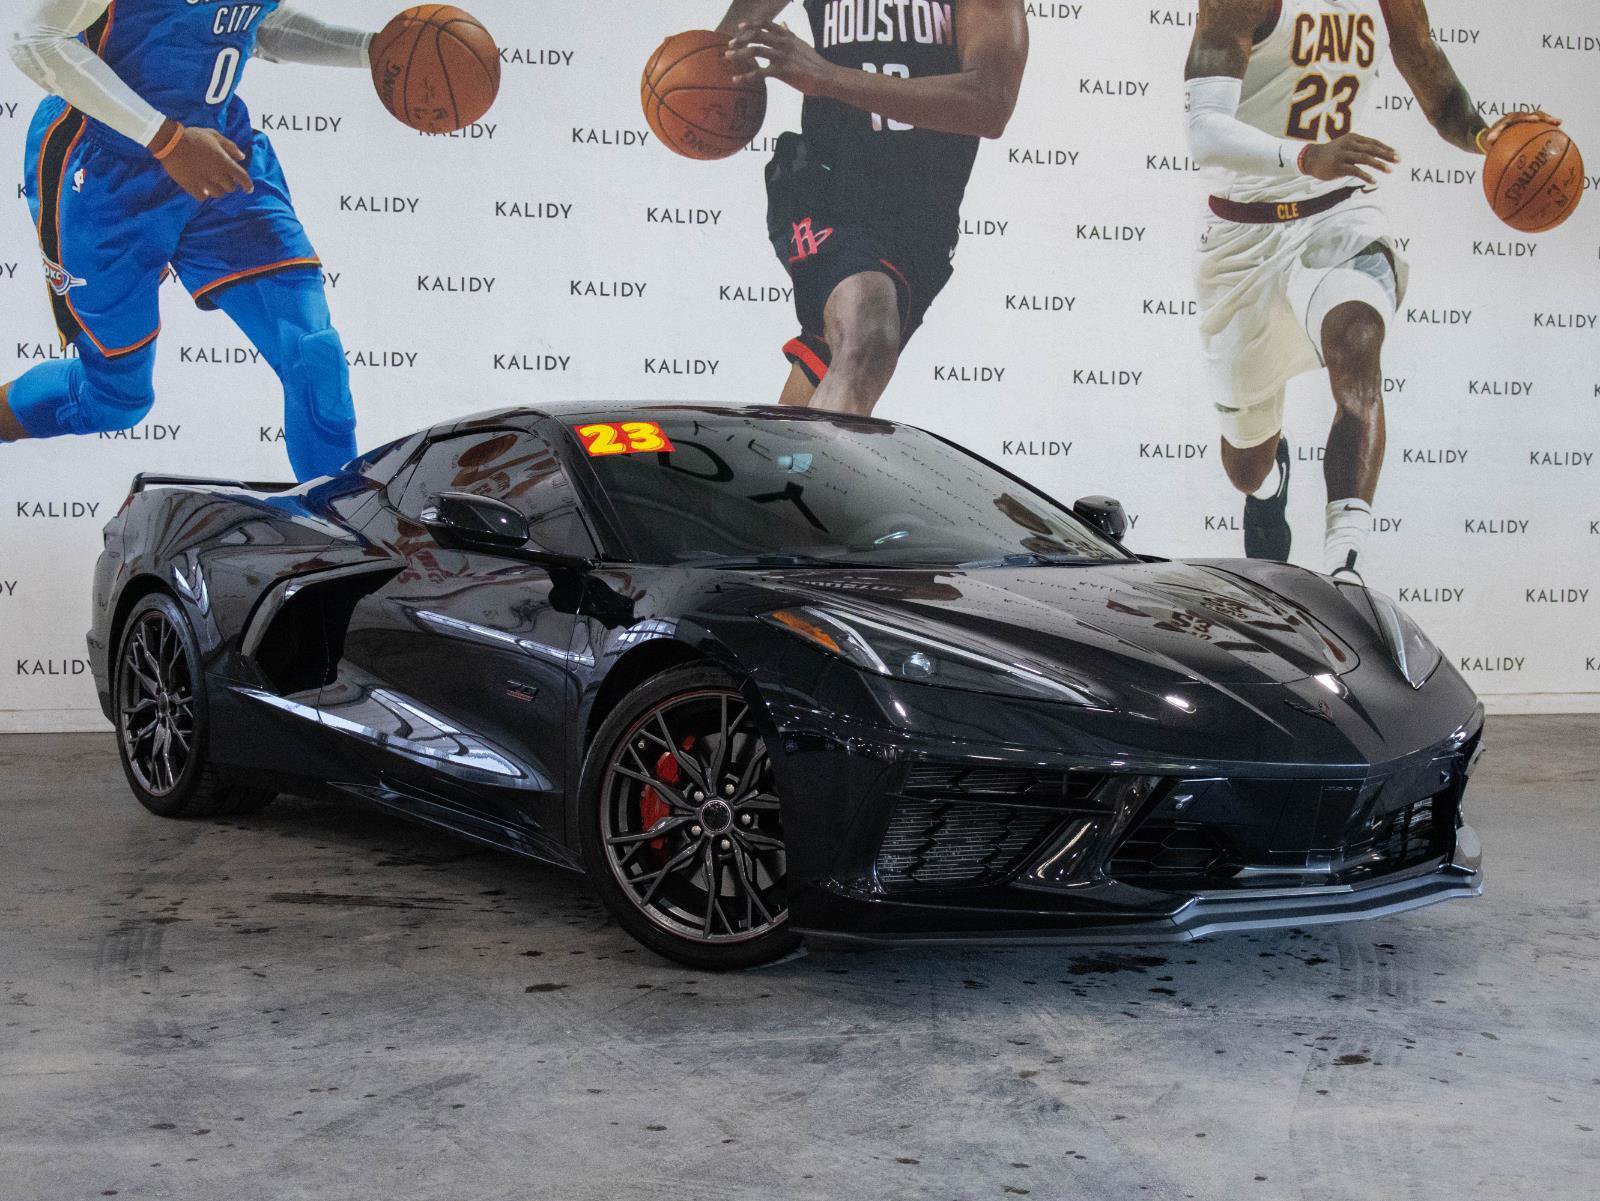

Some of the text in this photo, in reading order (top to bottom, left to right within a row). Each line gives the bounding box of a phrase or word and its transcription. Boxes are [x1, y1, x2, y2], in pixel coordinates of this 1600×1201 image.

[213, 5, 261, 35] CITY
[1026, 3, 1083, 21] ALIDY
[1150, 10, 1199, 27] KALI
[823, 0, 952, 48] HOUSTON
[1290, 12, 1376, 69] CAVS
[1428, 28, 1480, 44] ALIDY
[498, 48, 575, 66] KALIDY
[205, 47, 240, 105] 0
[1080, 79, 1150, 96] KALIDY
[1284, 72, 1361, 142] 23
[262, 114, 341, 132] KALIDY
[572, 128, 649, 146] KALIDY
[1009, 148, 1079, 166] KALIDY
[1411, 168, 1475, 184] KALIDY
[340, 195, 418, 213] KALIDY
[495, 202, 572, 219] KALIDY
[1276, 203, 1300, 220] CLE
[647, 208, 722, 225] KALIDY
[958, 220, 1009, 236] LIDY
[1077, 225, 1146, 242] KALIDY
[1473, 241, 1537, 257] KALIDY
[417, 276, 495, 293] KALIDY
[570, 281, 647, 298] KALIDY
[720, 286, 793, 303] KALIDY
[1006, 295, 1075, 312] KALIDY
[1143, 300, 1197, 316] KALID
[1407, 309, 1472, 325] KALIDY
[1534, 313, 1597, 328] KALIDY
[17, 343, 77, 359] KALI
[181, 347, 260, 364] KALIDY
[494, 355, 570, 371] KALIDY
[644, 359, 719, 374] KALIDY
[934, 367, 1005, 383] KALIDY
[1073, 370, 1142, 386] KALIDY
[1469, 381, 1533, 395] KALIDY
[579, 422, 665, 454] 23
[1003, 441, 1073, 456] KALIDY
[1140, 444, 1207, 459] KALIDY
[1403, 449, 1468, 463] KALIDY
[1530, 452, 1593, 466] KALIDY
[17, 502, 99, 518] KALIDY
[1465, 520, 1529, 534] KALIDY
[1399, 589, 1464, 602] KALIDY
[1525, 589, 1588, 602] KALIDY
[1461, 657, 1525, 671] KALIDY
